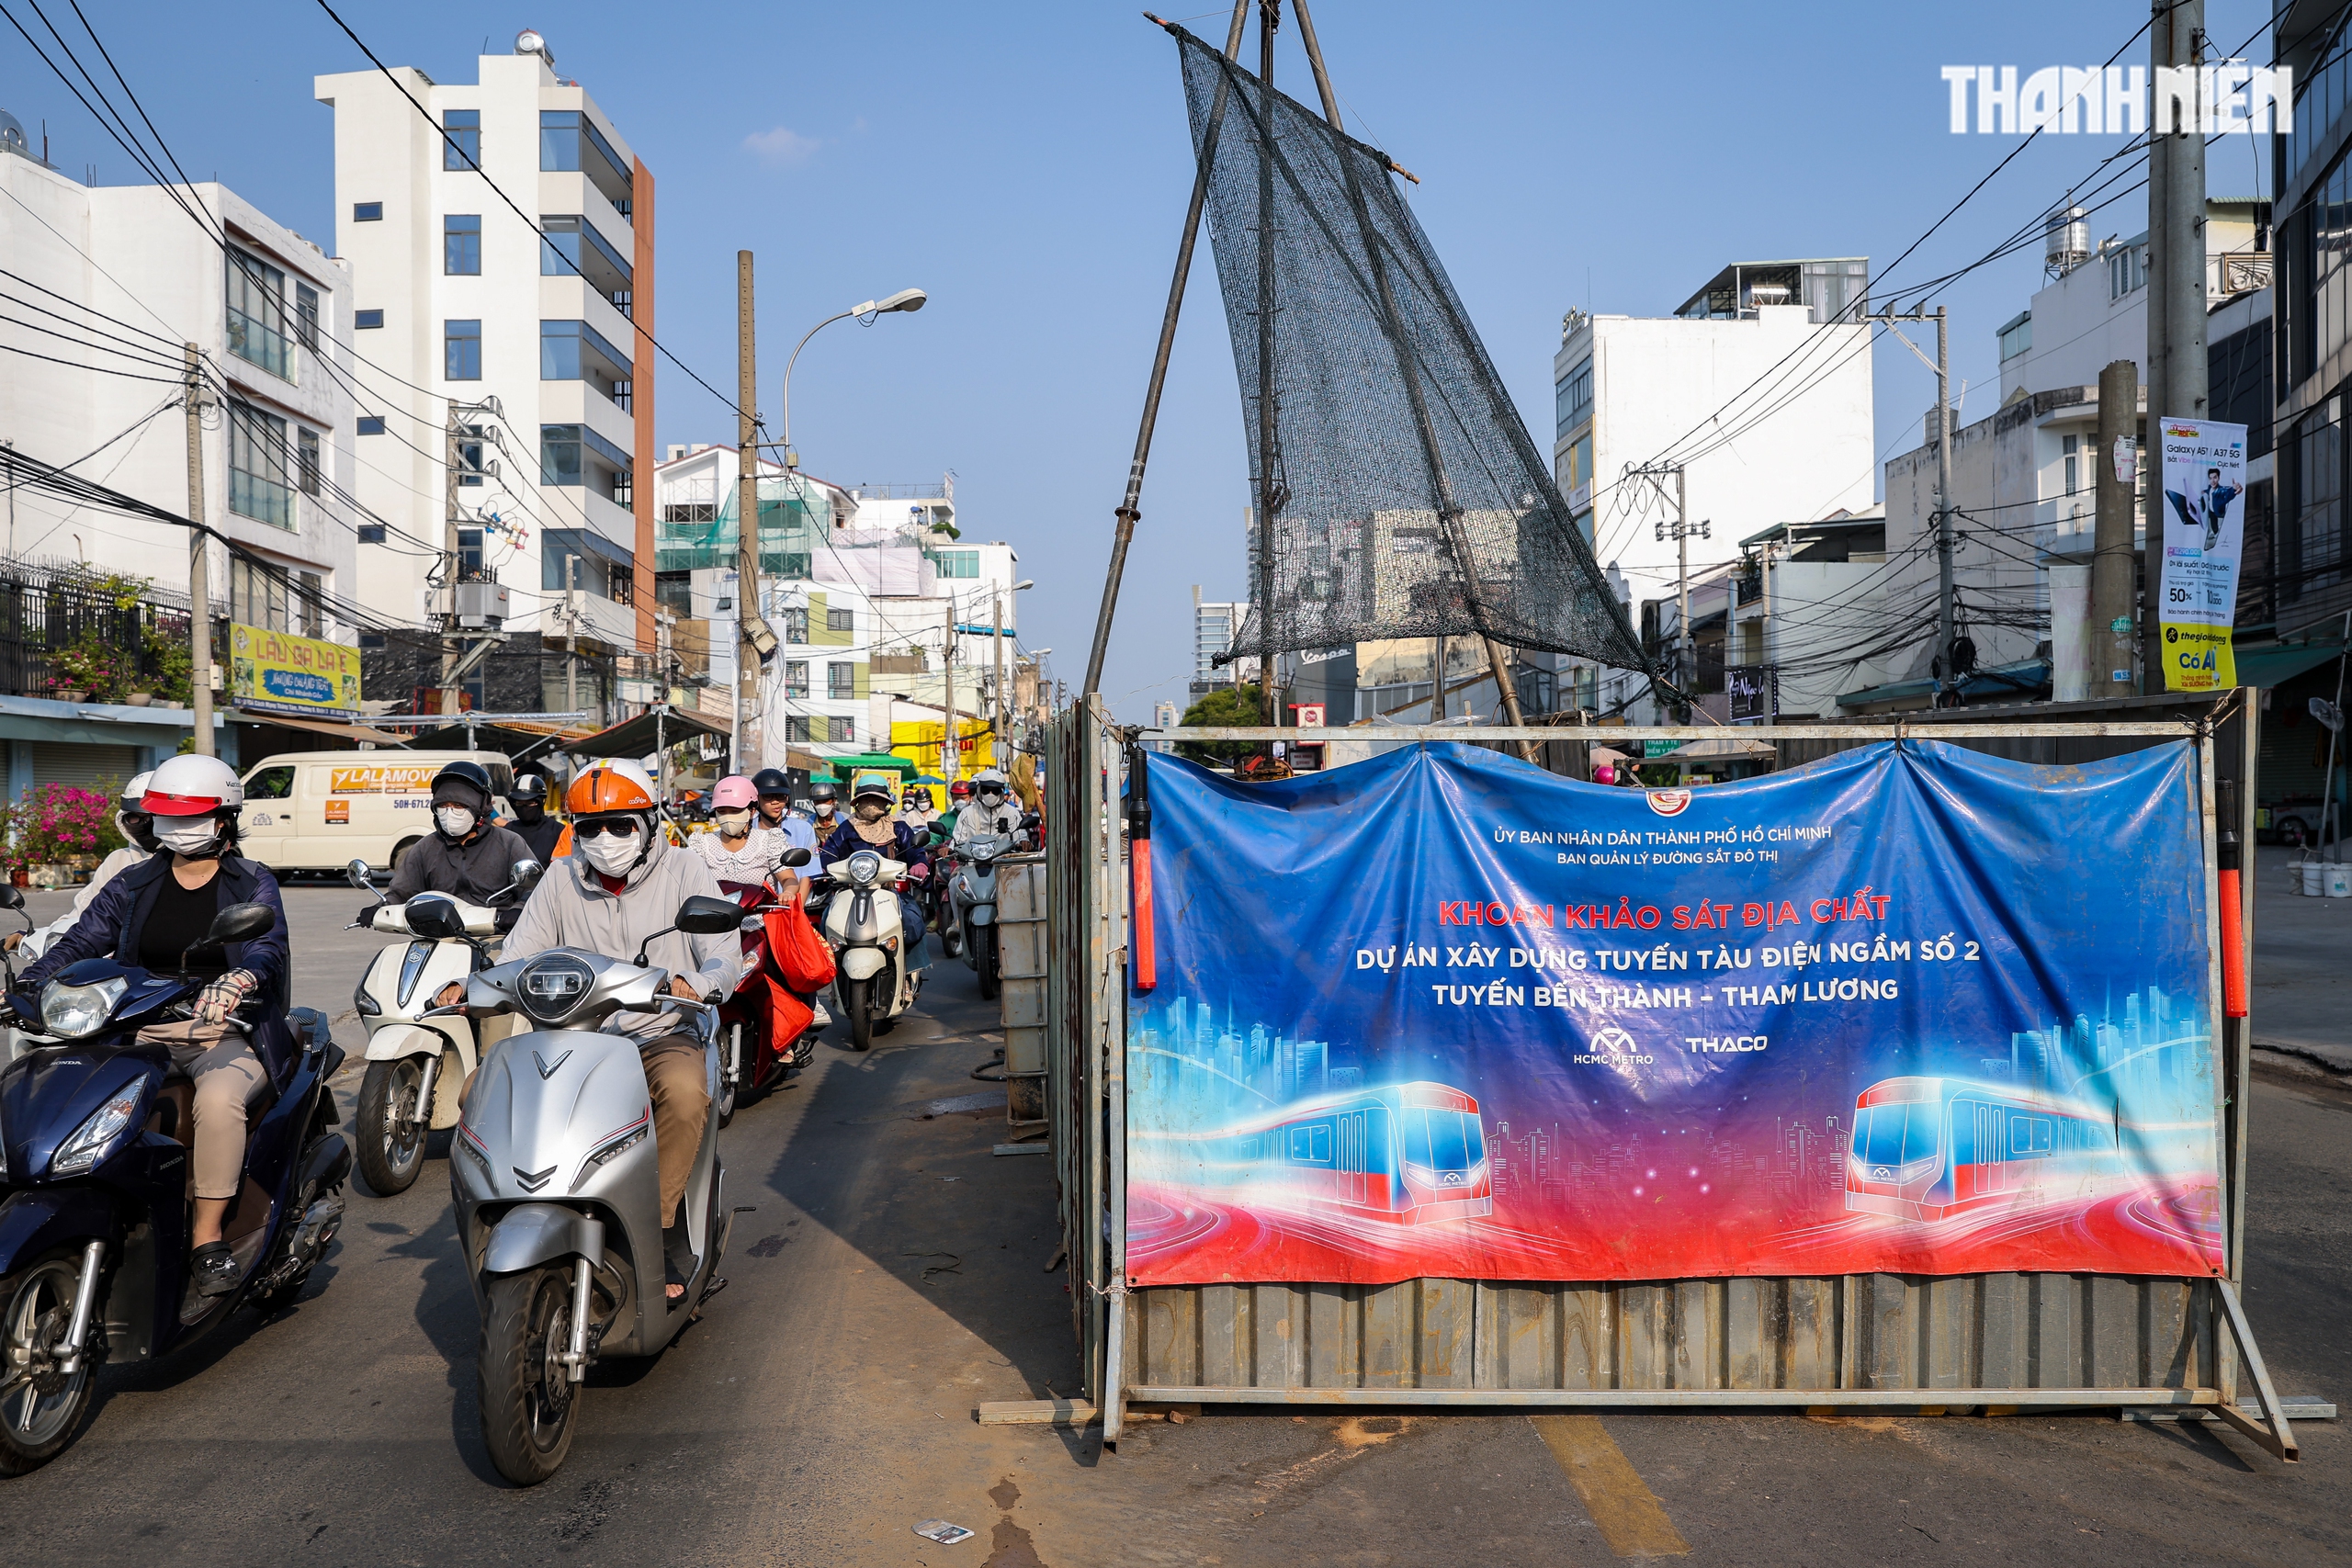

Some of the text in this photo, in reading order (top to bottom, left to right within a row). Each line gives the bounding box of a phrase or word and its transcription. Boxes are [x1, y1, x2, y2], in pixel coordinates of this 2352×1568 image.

[2166, 444, 2196, 457] Galaxy
[2213, 448, 2228, 457] A37
[2229, 449, 2240, 458] 5G
[2169, 587, 2192, 603] 50%
[2179, 649, 2216, 671] Có AI
[394, 799, 433, 809] 50H-671.2
[1494, 824, 1832, 845] ỦY BAN NHÂN DÂN THÀNH PHỐ HỒ CHÍ MINH
[1557, 847, 1779, 865] BAN QUẢN LÝ ĐƯỜNG SẮT ĐÔ THỊ
[1439, 886, 1891, 932] KHOAN KHẢO SÁT ĐỊA CHẤT
[1356, 931, 1980, 974] DỰ ÁN XÂY DỰNG TUYẾN TÀU ĐIỆN NGẦM SỐ 2
[1431, 976, 1525, 1007] TUYẾN
[1534, 978, 1586, 1008] BẾN
[1596, 983, 1691, 1009] THÀNH
[1721, 983, 1797, 1007] THAM
[1804, 977, 1898, 1002] LƯƠNG
[1685, 1035, 1768, 1053] THACO
[1574, 1055, 1654, 1065] HCMC METRO
[160, 1155, 184, 1170] HONDA
